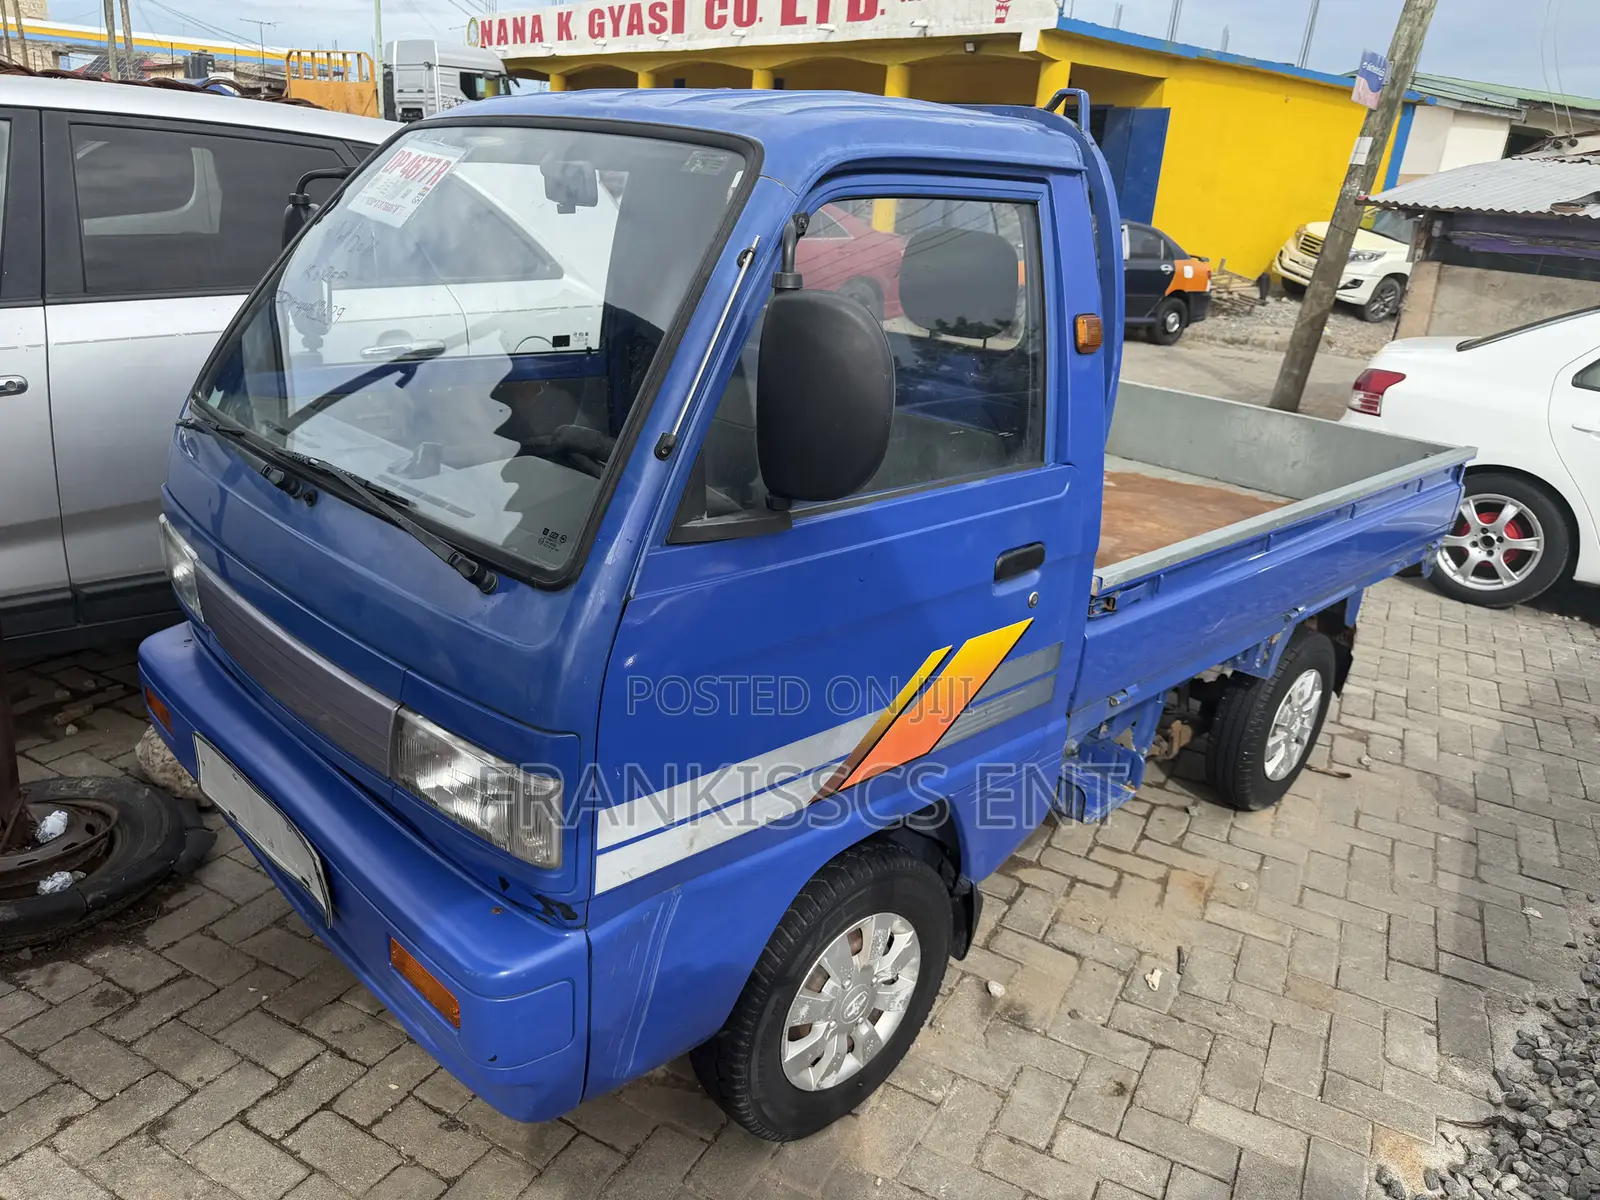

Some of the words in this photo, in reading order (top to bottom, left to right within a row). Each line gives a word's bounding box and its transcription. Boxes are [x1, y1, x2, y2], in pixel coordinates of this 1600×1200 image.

[480, 14, 544, 46] NANA
[588, 0, 686, 39] GYASI
[705, 0, 763, 30] CO.
